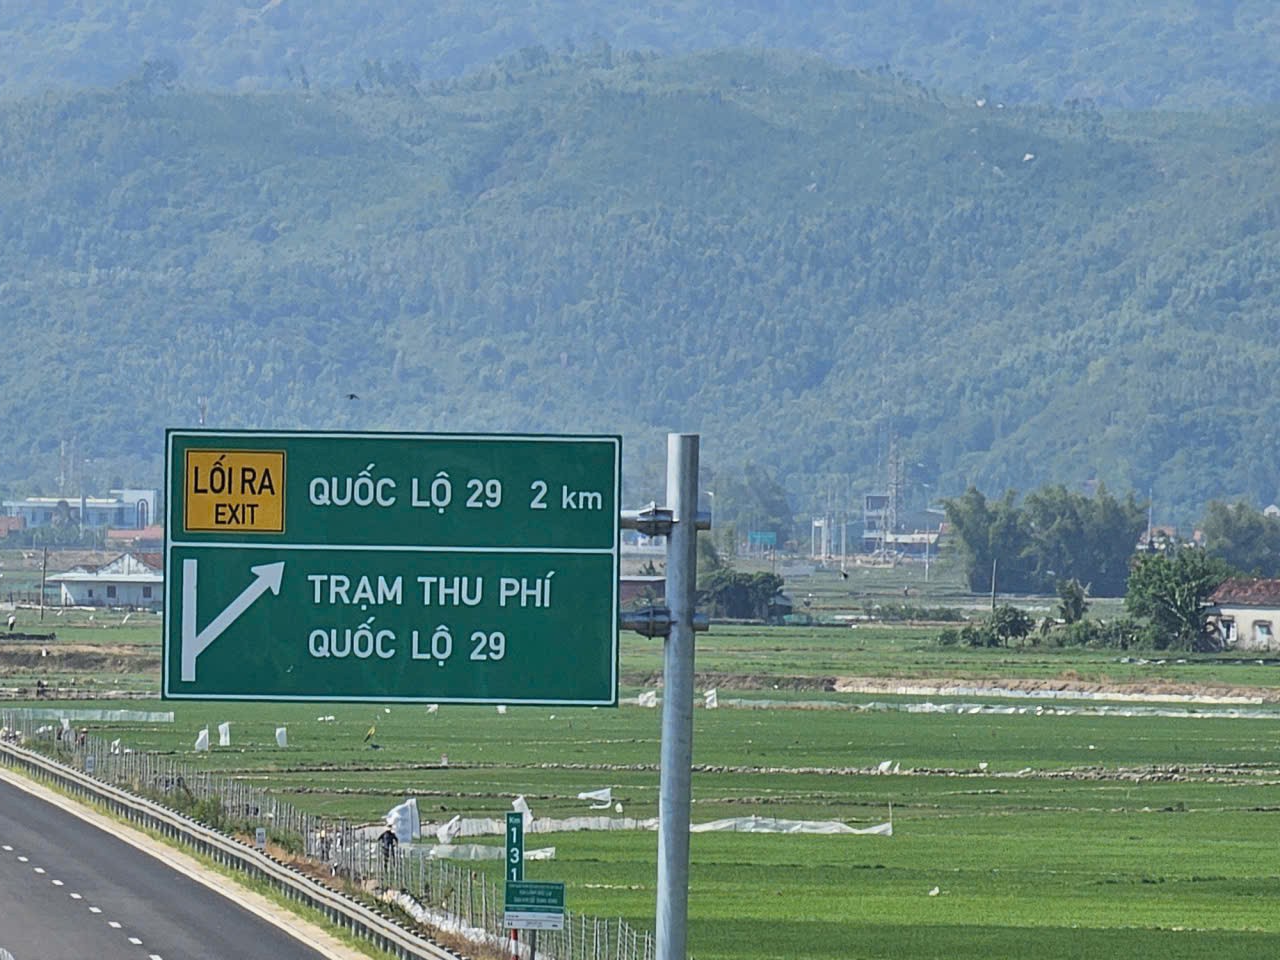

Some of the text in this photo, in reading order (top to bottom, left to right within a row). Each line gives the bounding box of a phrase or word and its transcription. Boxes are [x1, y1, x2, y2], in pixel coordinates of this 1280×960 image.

[194, 455, 275, 495] LỐI RA
[309, 464, 602, 514] QUỐC LỘ 29 2 km
[215, 503, 259, 525] EXIT
[308, 571, 556, 611] TRẠM THU PHÍ
[309, 616, 506, 667] QUỐC LỘ 29
